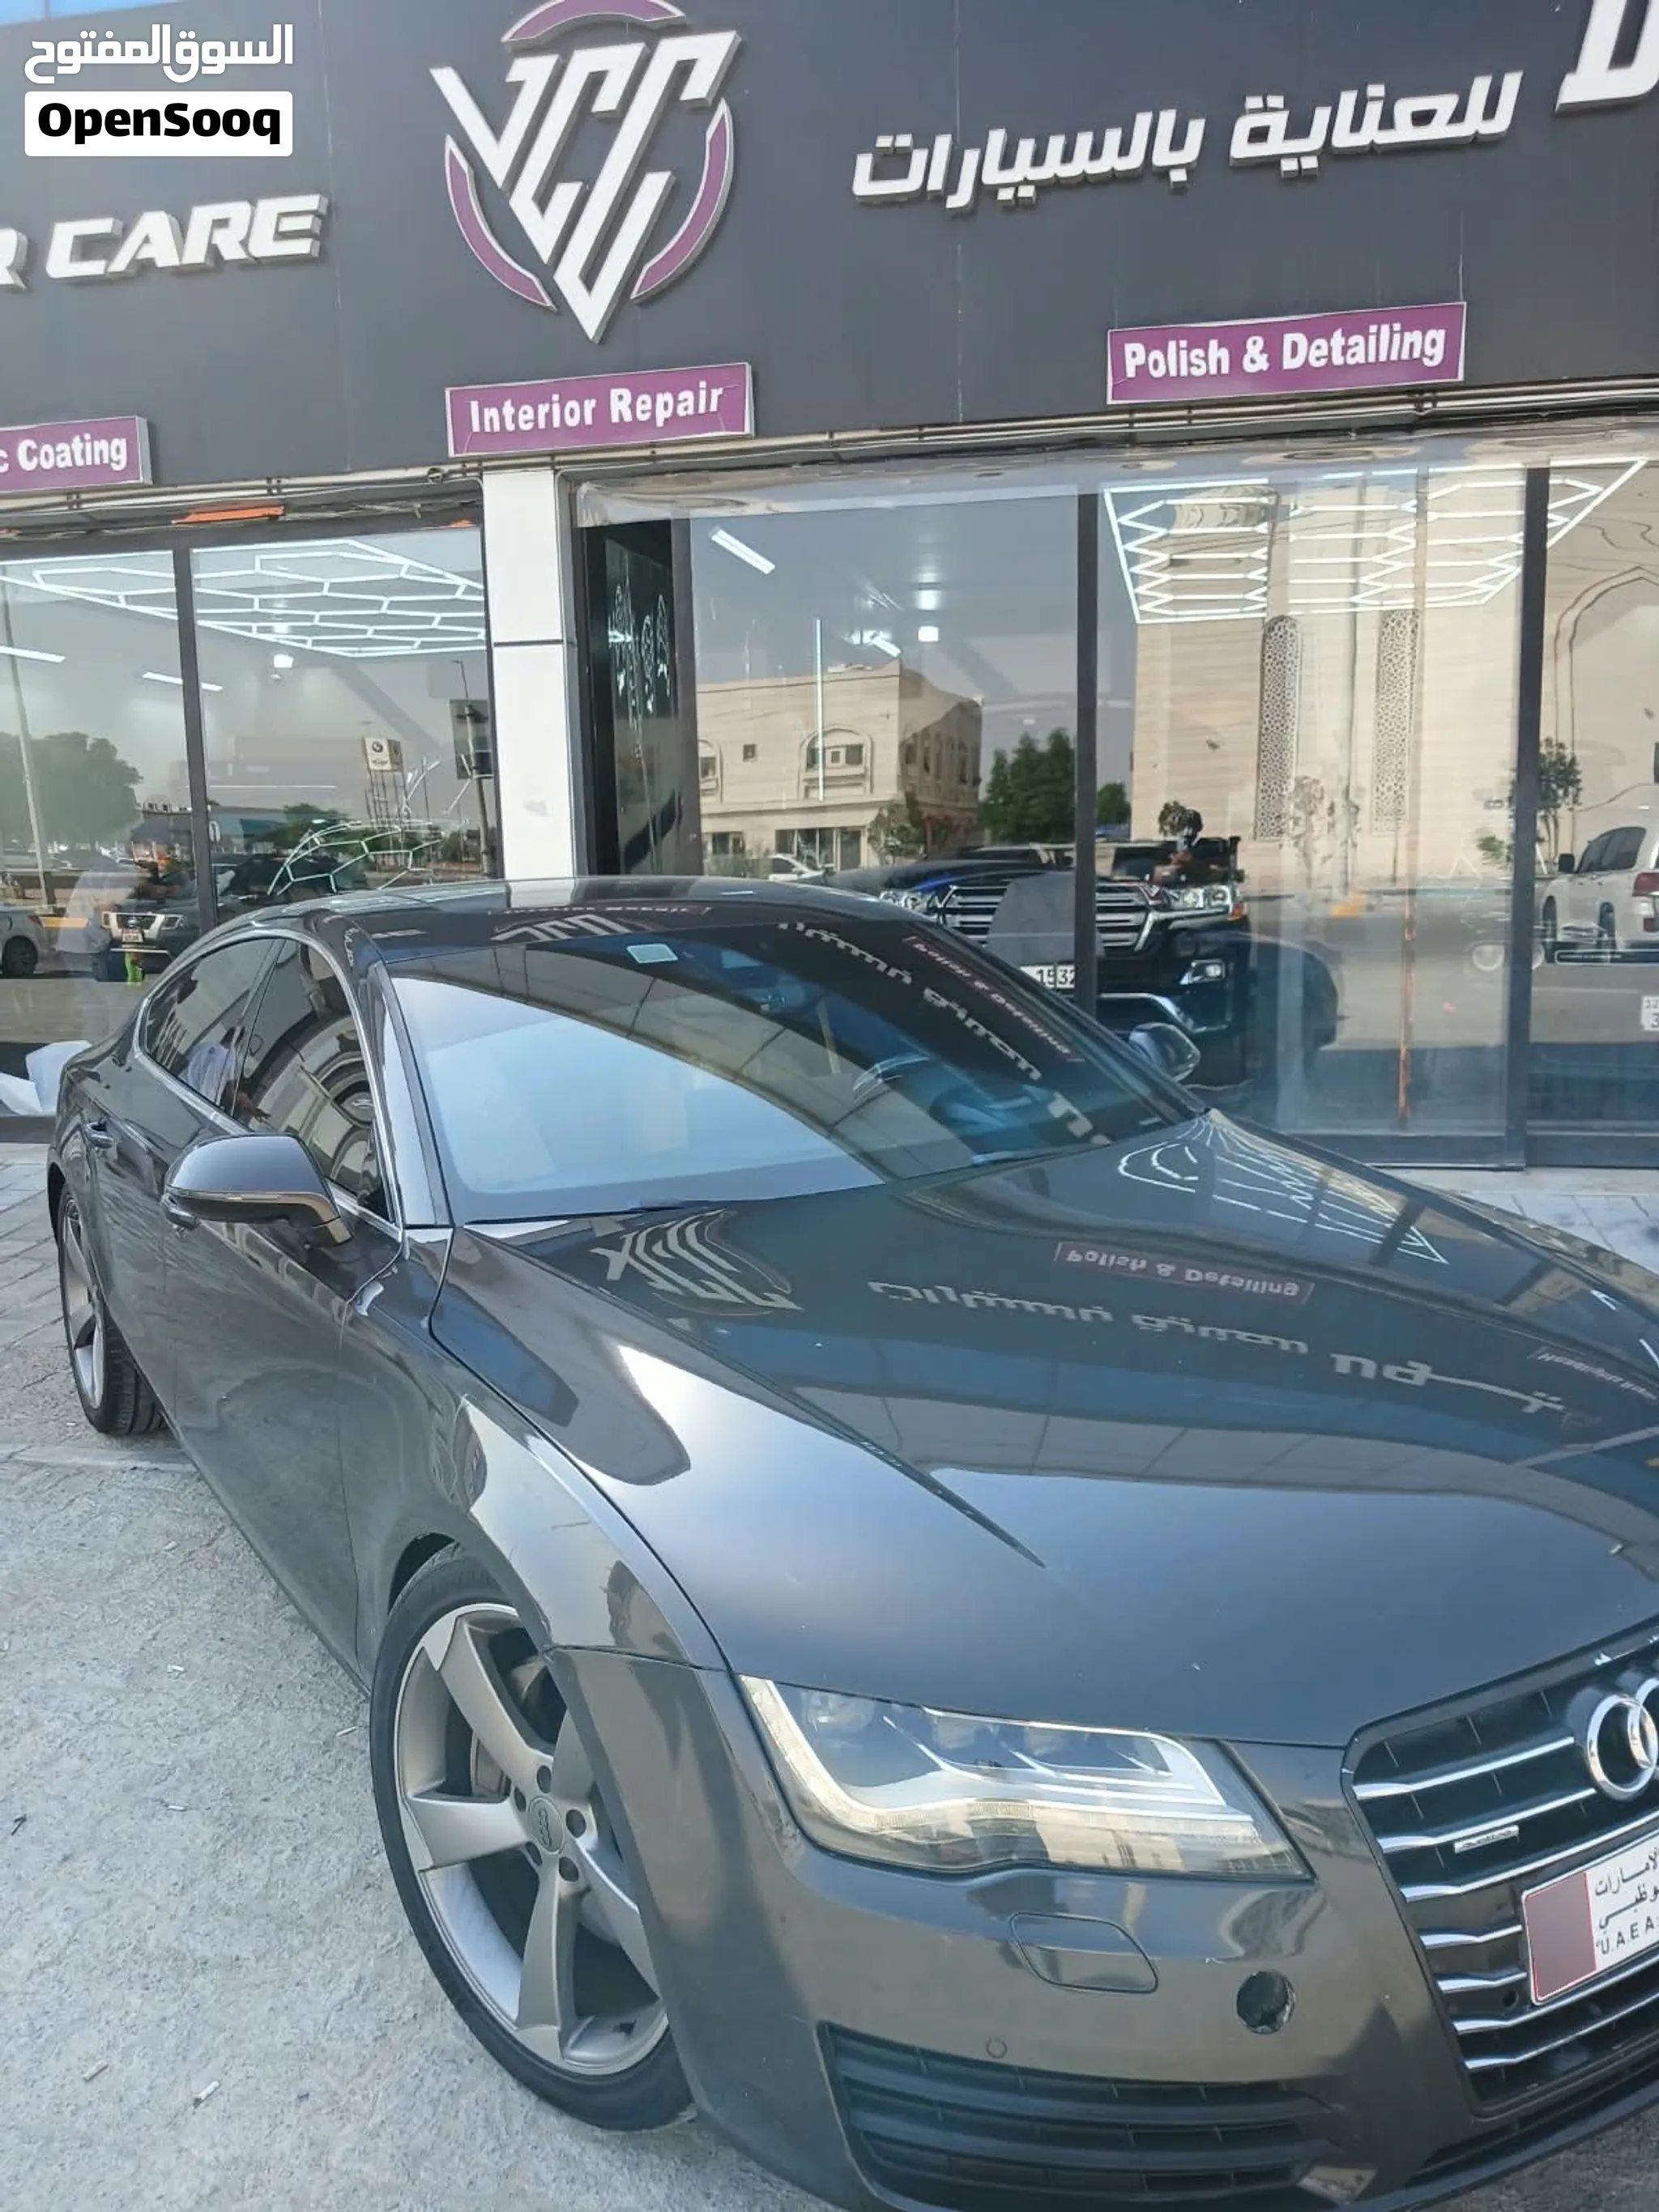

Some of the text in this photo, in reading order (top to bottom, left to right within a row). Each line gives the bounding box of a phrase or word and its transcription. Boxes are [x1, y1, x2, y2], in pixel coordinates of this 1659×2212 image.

[1230, 70, 1523, 178] للعناية
[852, 109, 1206, 212] بالسيارات
[46, 194, 328, 280] CARE
[1124, 322, 1446, 379] Polish & Detailing
[470, 381, 723, 433] Interior Repair
[17, 433, 128, 471] Coating
